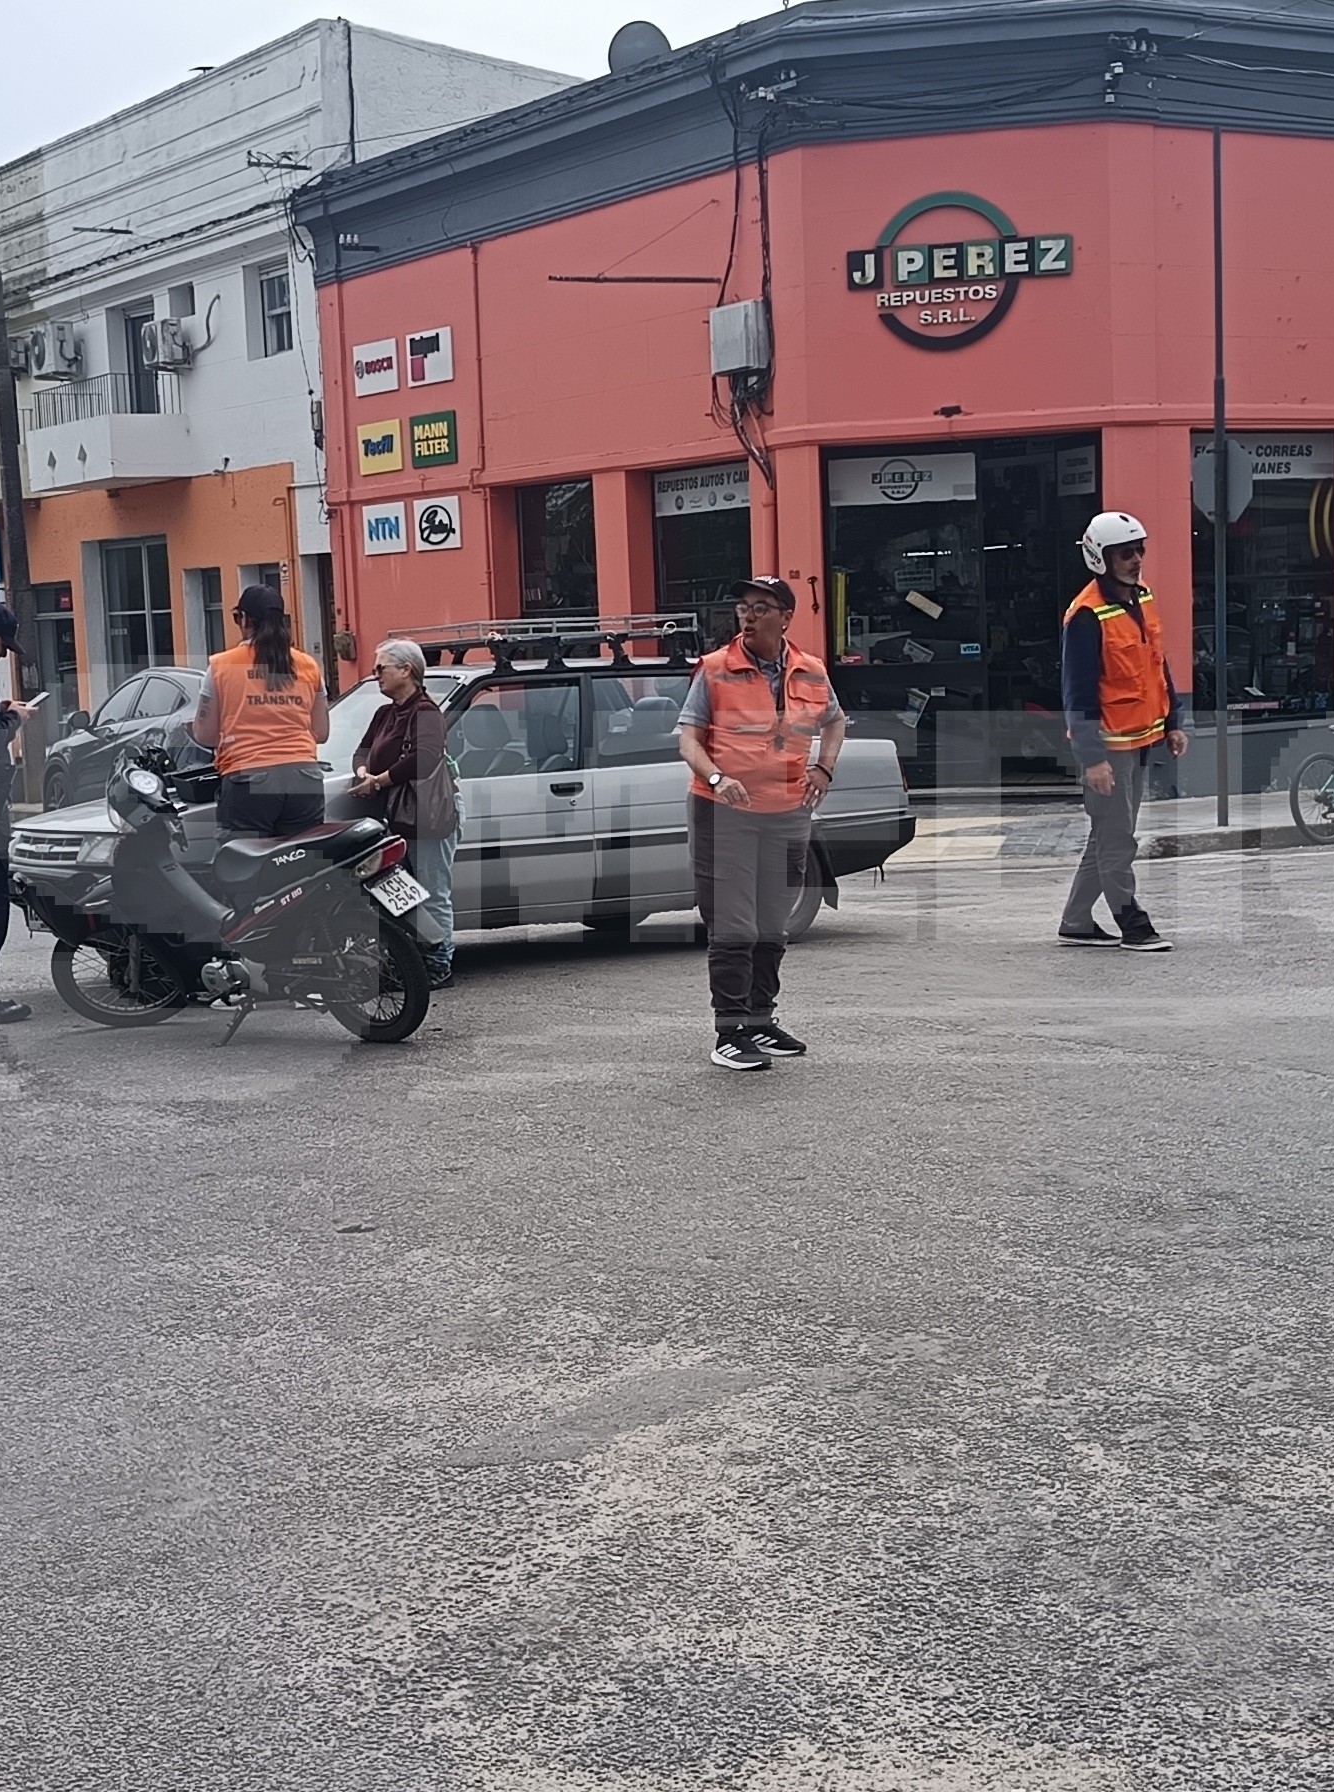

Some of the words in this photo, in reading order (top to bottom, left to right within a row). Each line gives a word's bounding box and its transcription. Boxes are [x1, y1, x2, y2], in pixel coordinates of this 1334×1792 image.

[853, 253, 876, 286] J
[897, 239, 1068, 282] PEREZ
[876, 284, 998, 308] REPUESTOS
[919, 308, 977, 326] S.R.L.
[413, 421, 448, 441] MANN
[414, 438, 449, 457] FILTER
[1255, 445, 1313, 457] CORREAS
[657, 477, 698, 494] REPUESTOS
[700, 472, 724, 488] AUTOS
[725, 471, 732, 484] Y
[885, 471, 931, 482] PEREZ
[367, 516, 400, 542] NTN
[272, 849, 307, 867] TANGO
[379, 875, 409, 898] KCH
